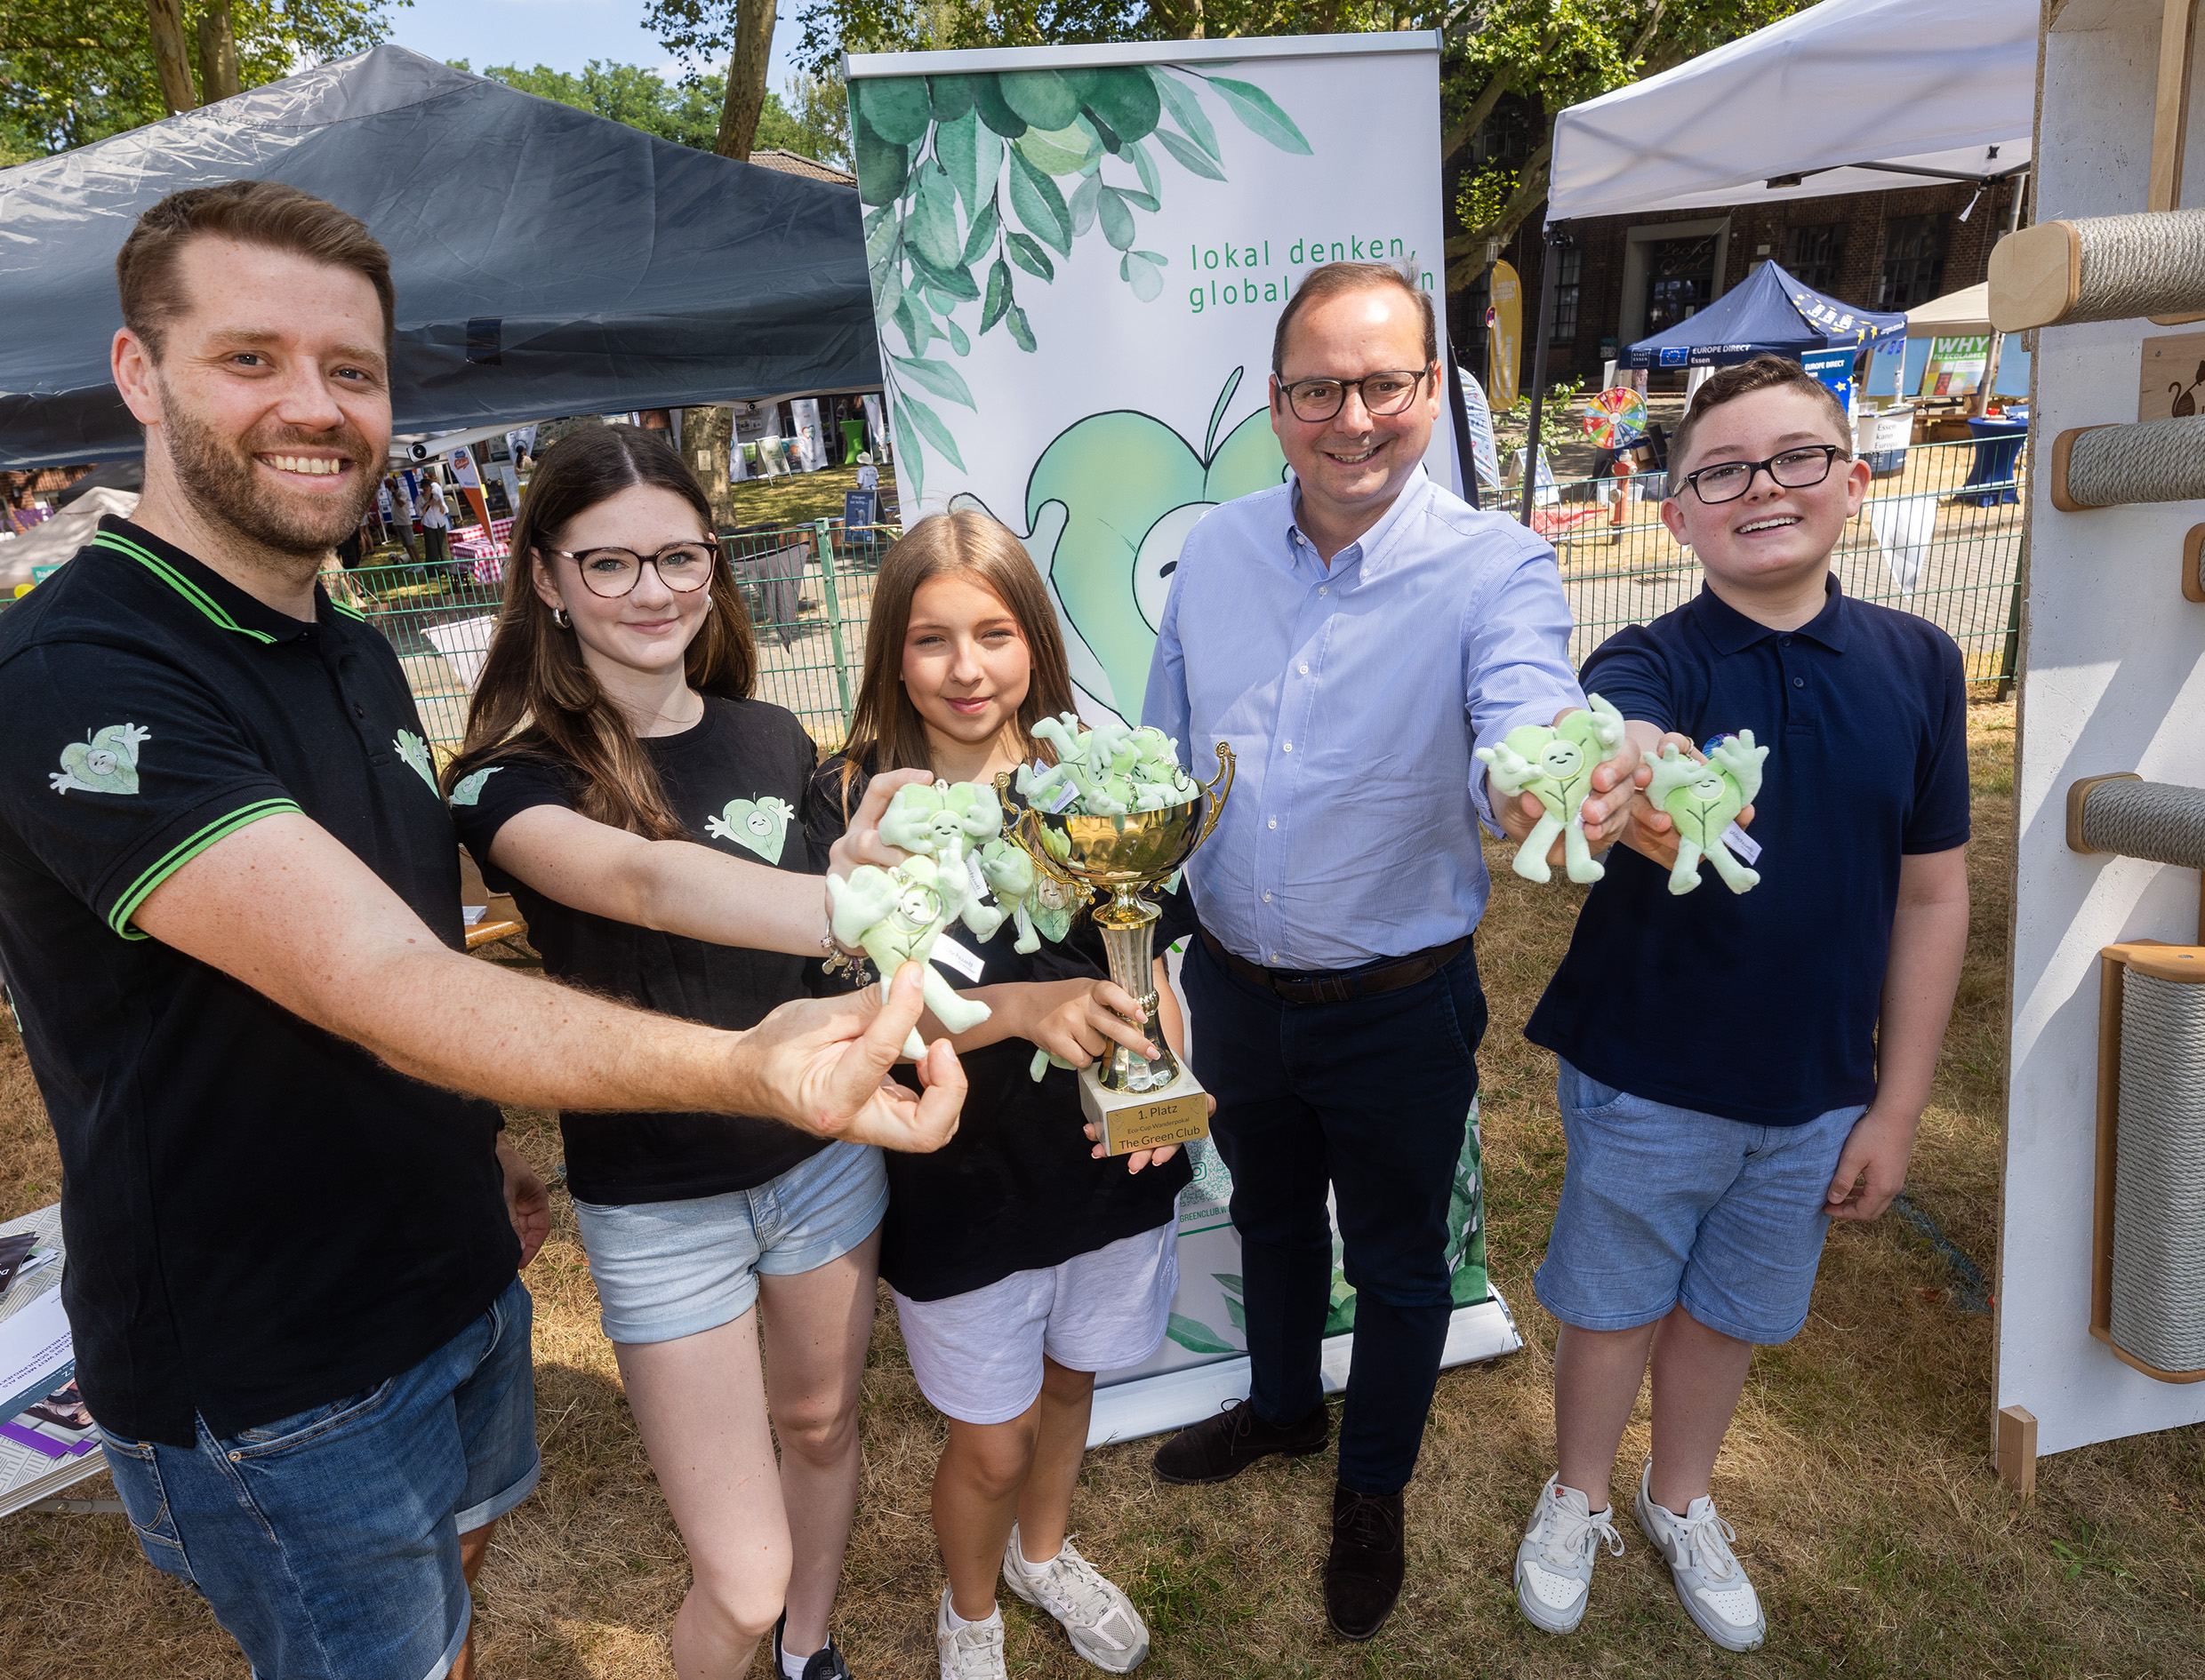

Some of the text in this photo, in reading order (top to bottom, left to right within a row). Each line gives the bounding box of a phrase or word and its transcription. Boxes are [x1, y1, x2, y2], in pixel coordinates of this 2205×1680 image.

[1191, 235, 1416, 270] lokal denken,
[1189, 276, 1289, 314] global
[1692, 344, 1752, 355] EUROPE DIRECT
[1938, 336, 1990, 353] WHY
[1805, 359, 1845, 371] EUROPE DIRECT
[1877, 423, 1896, 431] Essen
[1138, 1104, 1178, 1120] 1. Platz
[1127, 1116, 1191, 1134] Eco-Cup Wanderpokal
[1119, 1125, 1200, 1149] The Green Club
[17, 1366, 36, 1380] MEHR
[2, 1379, 16, 1388] ALS
